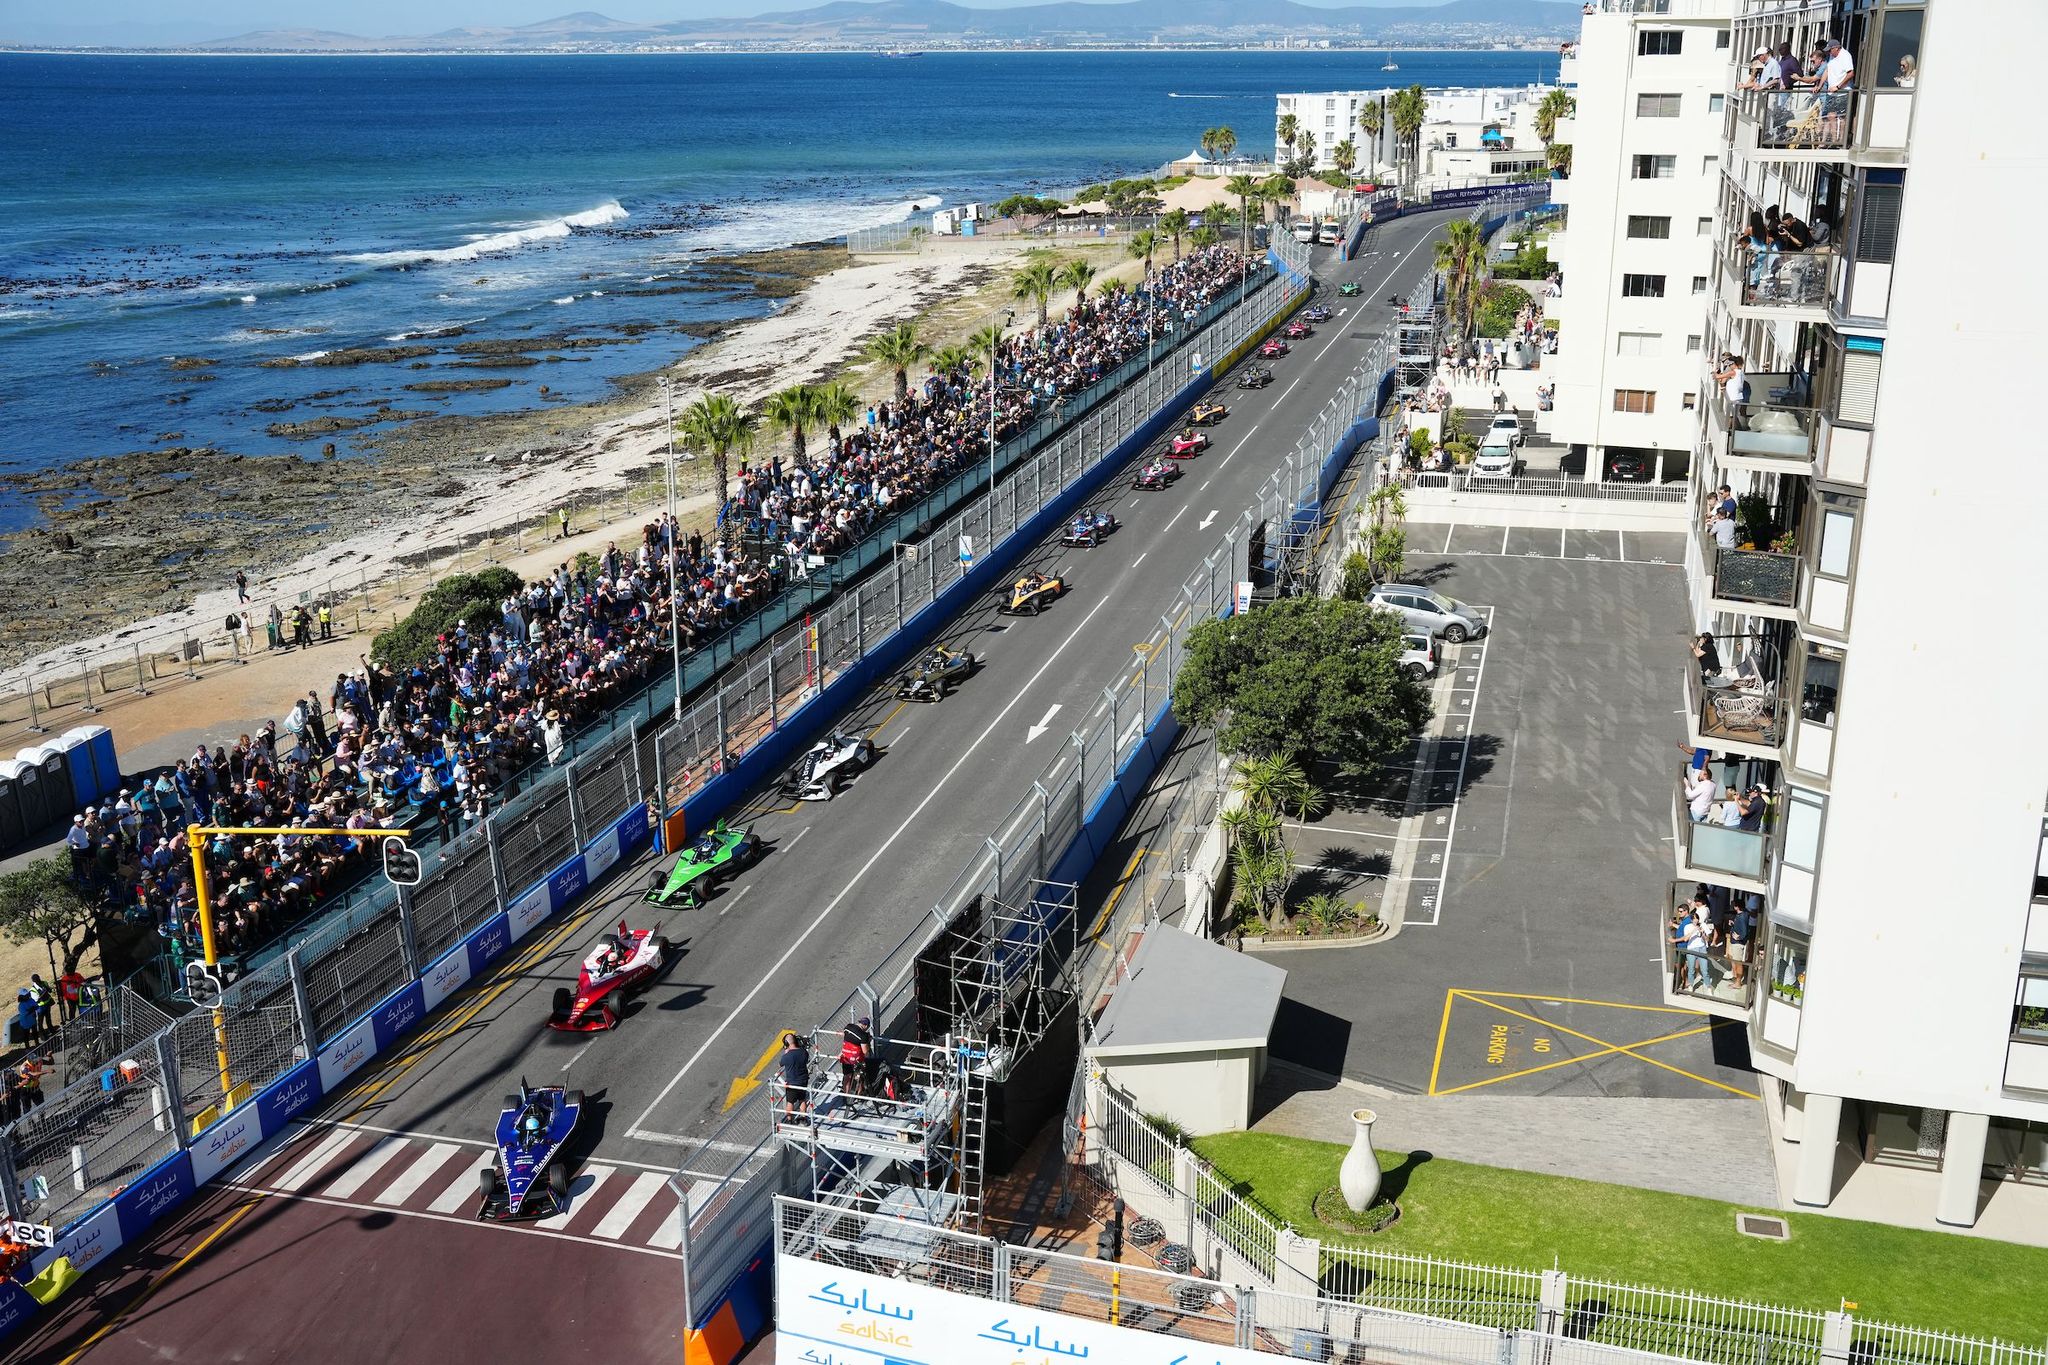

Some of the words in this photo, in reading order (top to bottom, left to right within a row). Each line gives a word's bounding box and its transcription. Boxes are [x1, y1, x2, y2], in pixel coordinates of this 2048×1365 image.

[1430, 853, 1441, 864] 709
[385, 998, 414, 1025] سابك
[332, 1037, 363, 1066] سابك
[1487, 1024, 1508, 1064] PARKING
[1533, 1038, 1551, 1053] NO
[272, 1079, 308, 1109] سابك
[207, 1124, 245, 1156] سابك
[134, 1173, 177, 1210] سابك
[149, 1188, 180, 1215] sabic
[18, 1226, 46, 1243] SC
[807, 1281, 913, 1321] سابك
[0, 1308, 19, 1328] bic
[837, 1320, 913, 1348] sabic
[977, 1319, 1088, 1358] سابك
